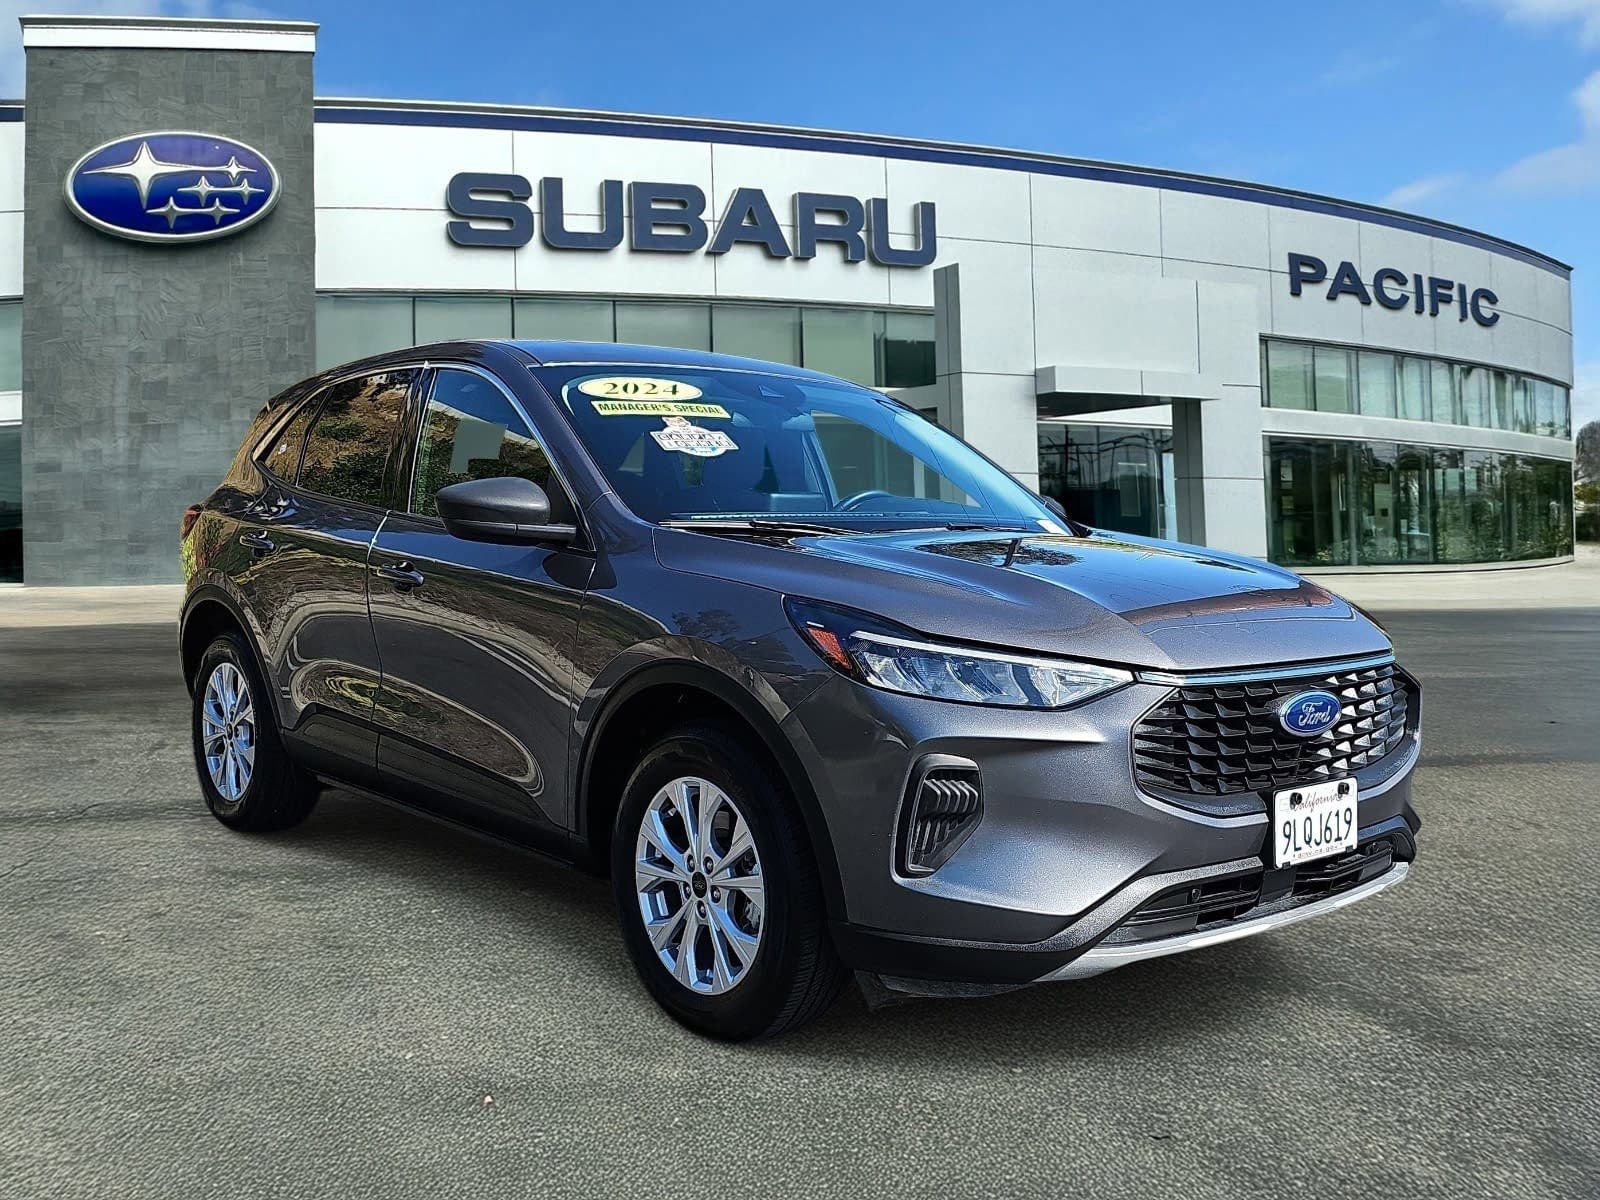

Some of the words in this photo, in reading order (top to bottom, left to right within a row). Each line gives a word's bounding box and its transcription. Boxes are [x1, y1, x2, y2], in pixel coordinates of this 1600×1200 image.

[446, 171, 938, 268] SUBARU
[1287, 252, 1500, 327] PACIFIC
[604, 382, 679, 395] 2024
[599, 403, 672, 412] MANAGER'S
[673, 404, 723, 415] SPECIAL
[1299, 701, 1331, 726] Ford
[1283, 807, 1352, 855] 9LQJ619
